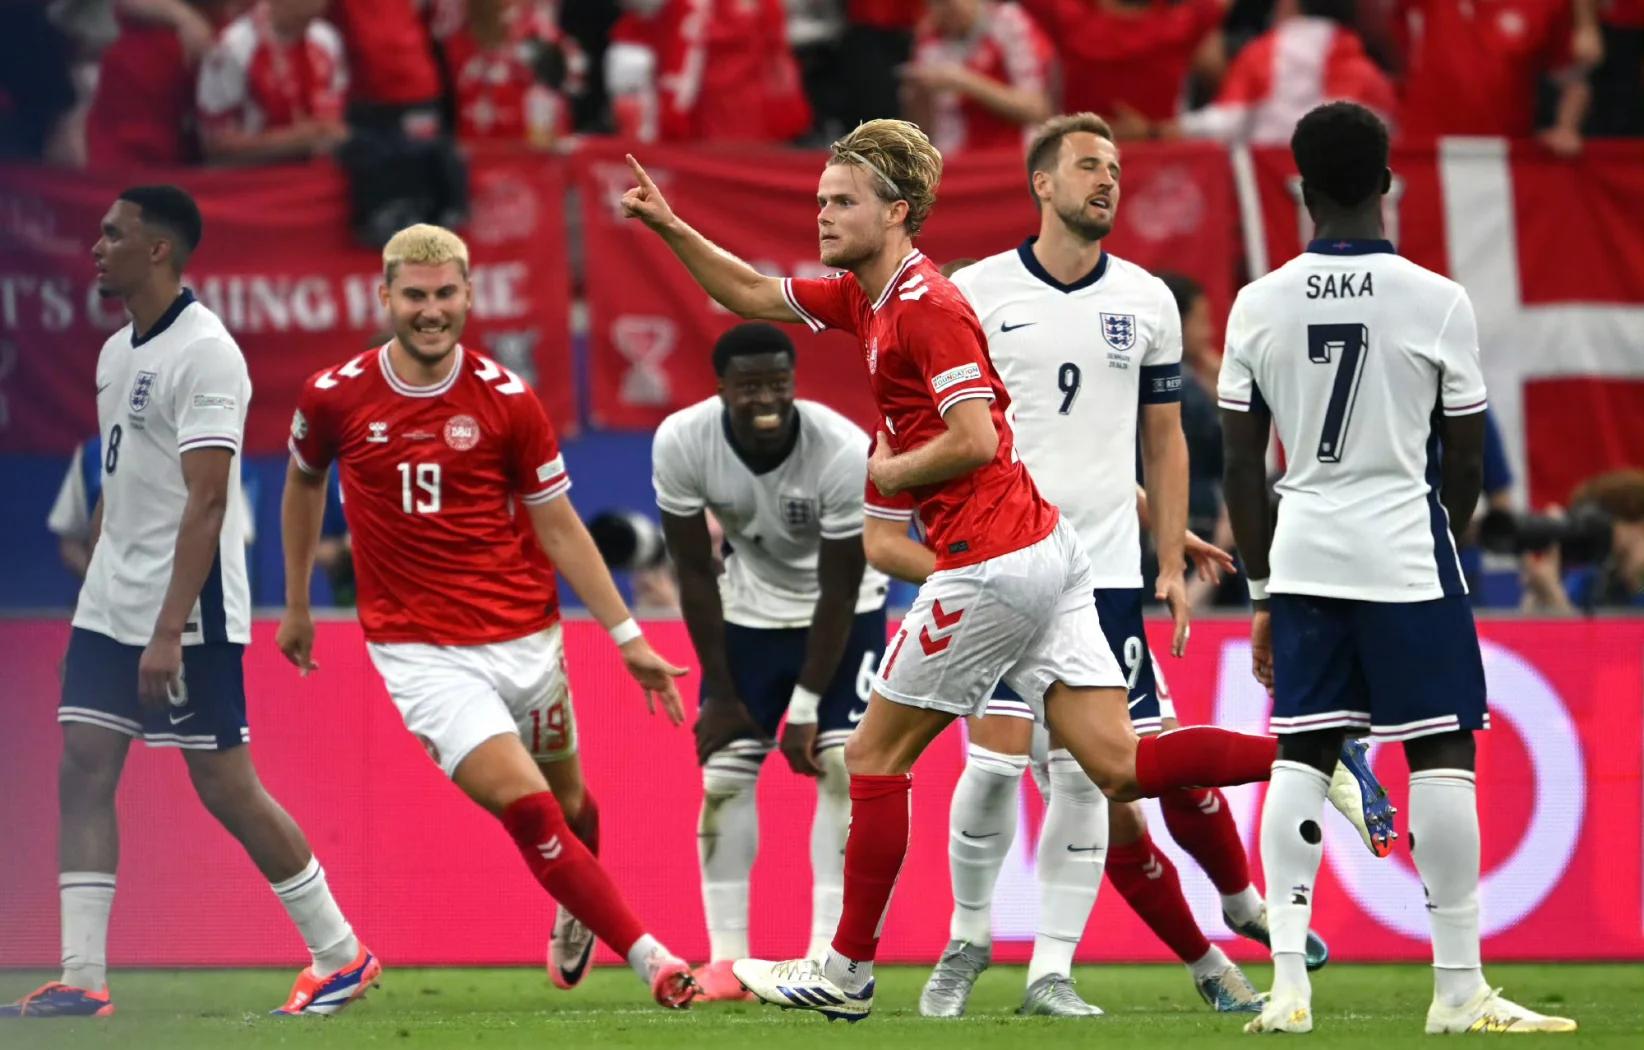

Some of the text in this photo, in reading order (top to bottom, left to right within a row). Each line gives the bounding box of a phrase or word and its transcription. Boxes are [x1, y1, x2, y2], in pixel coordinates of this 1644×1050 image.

[1306, 272, 1374, 300] SAKA
[1058, 362, 1081, 415] 9
[1307, 323, 1369, 463] 7
[105, 423, 122, 475] 8
[396, 461, 442, 515] 19
[855, 650, 877, 704] 6
[1123, 635, 1144, 690] 9
[529, 701, 569, 754] 19
